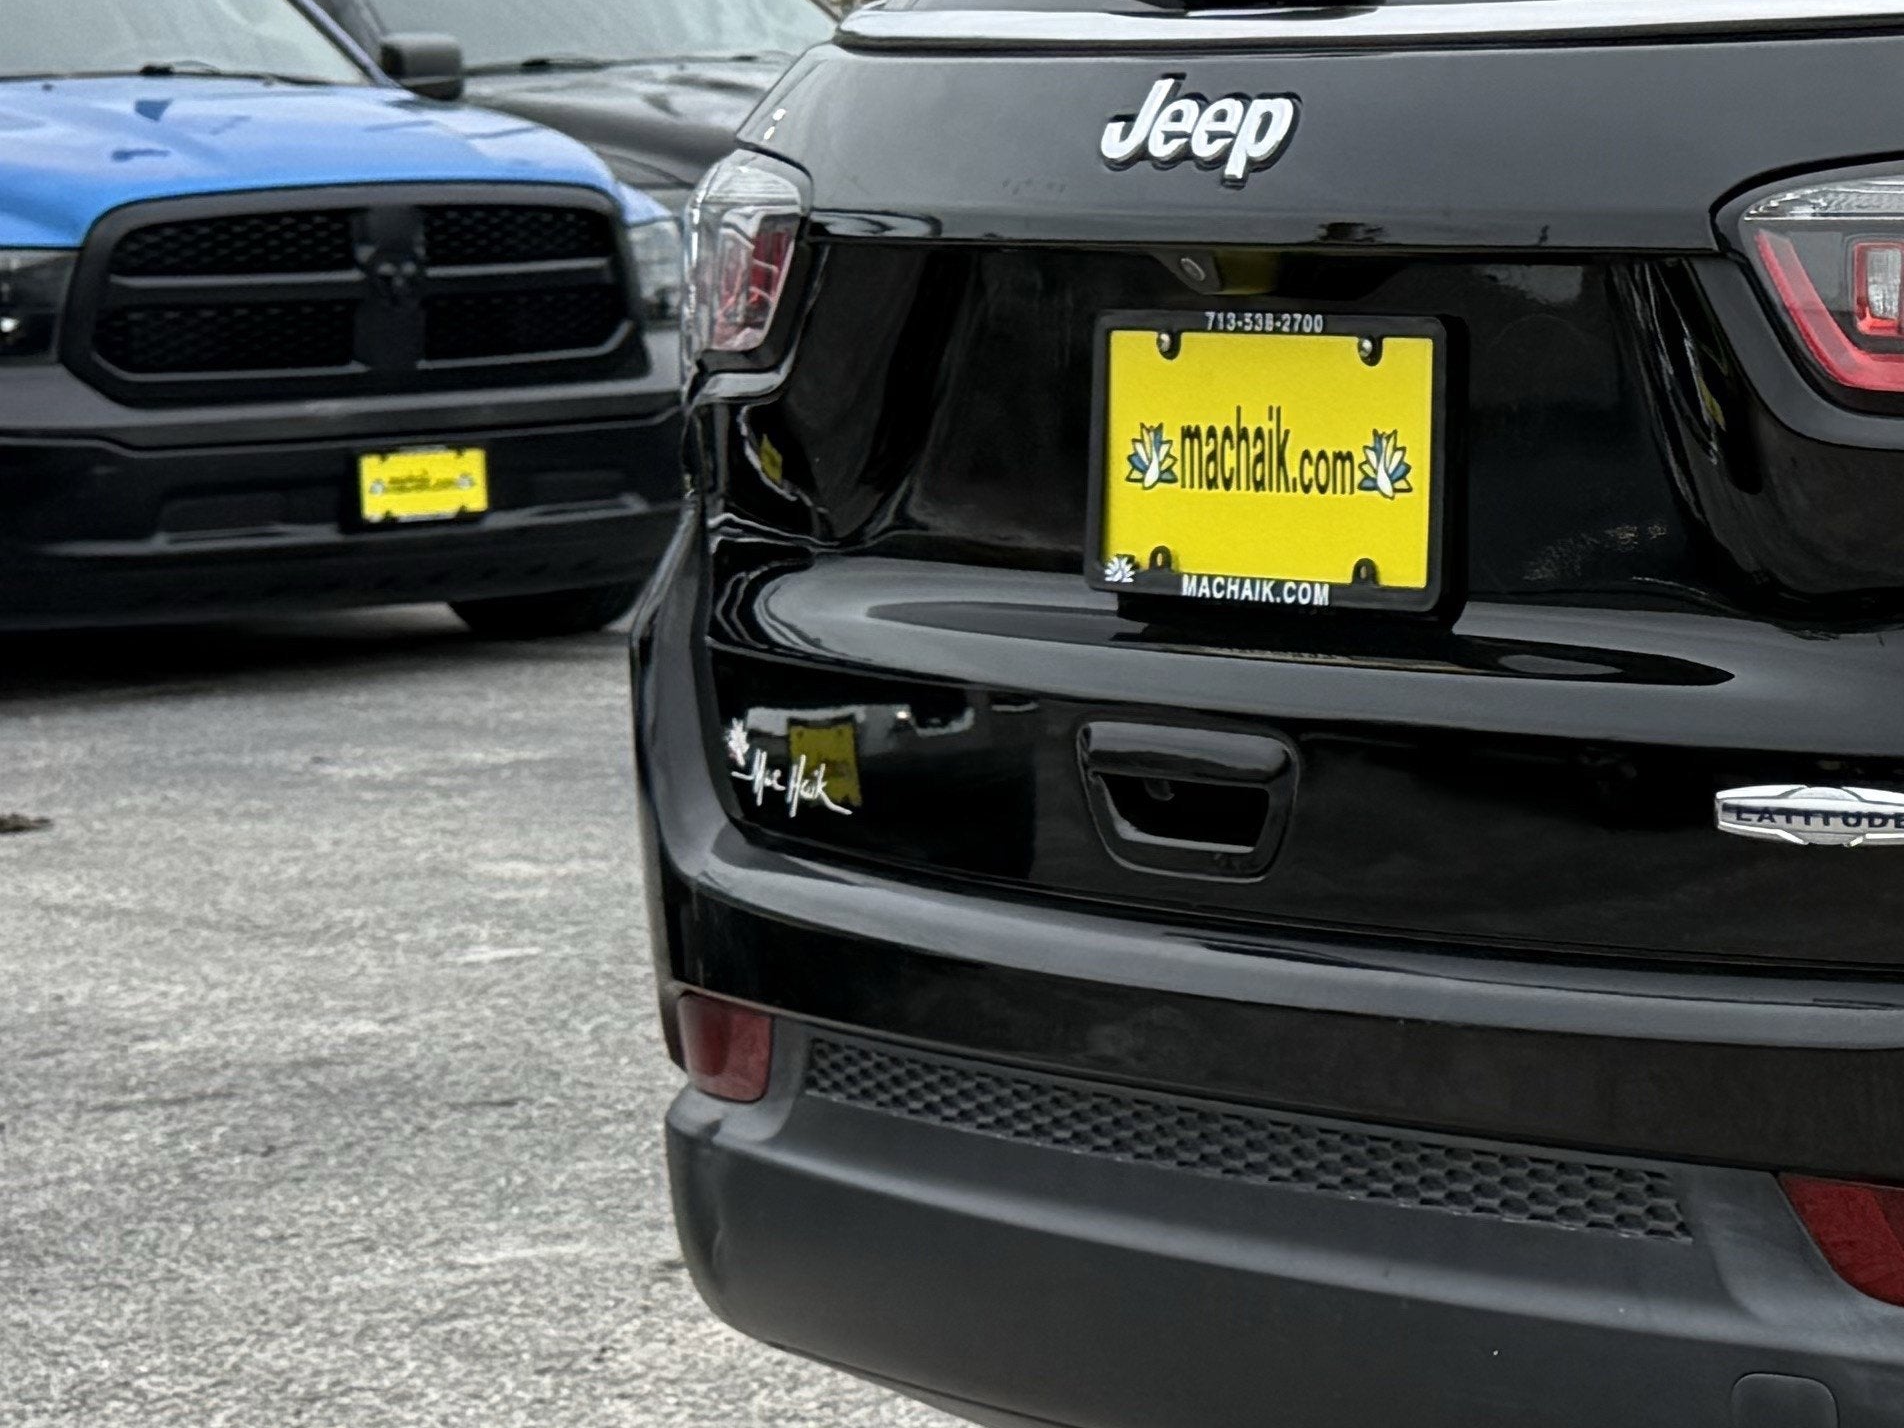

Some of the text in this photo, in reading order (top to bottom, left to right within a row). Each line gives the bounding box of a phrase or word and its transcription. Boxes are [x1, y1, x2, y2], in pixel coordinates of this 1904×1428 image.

[1101, 73, 1301, 186] Jeep
[1203, 310, 1325, 334] 713-538-2700
[1178, 404, 1356, 496] machaik.com
[1181, 573, 1331, 608] MACHAIK.COM
